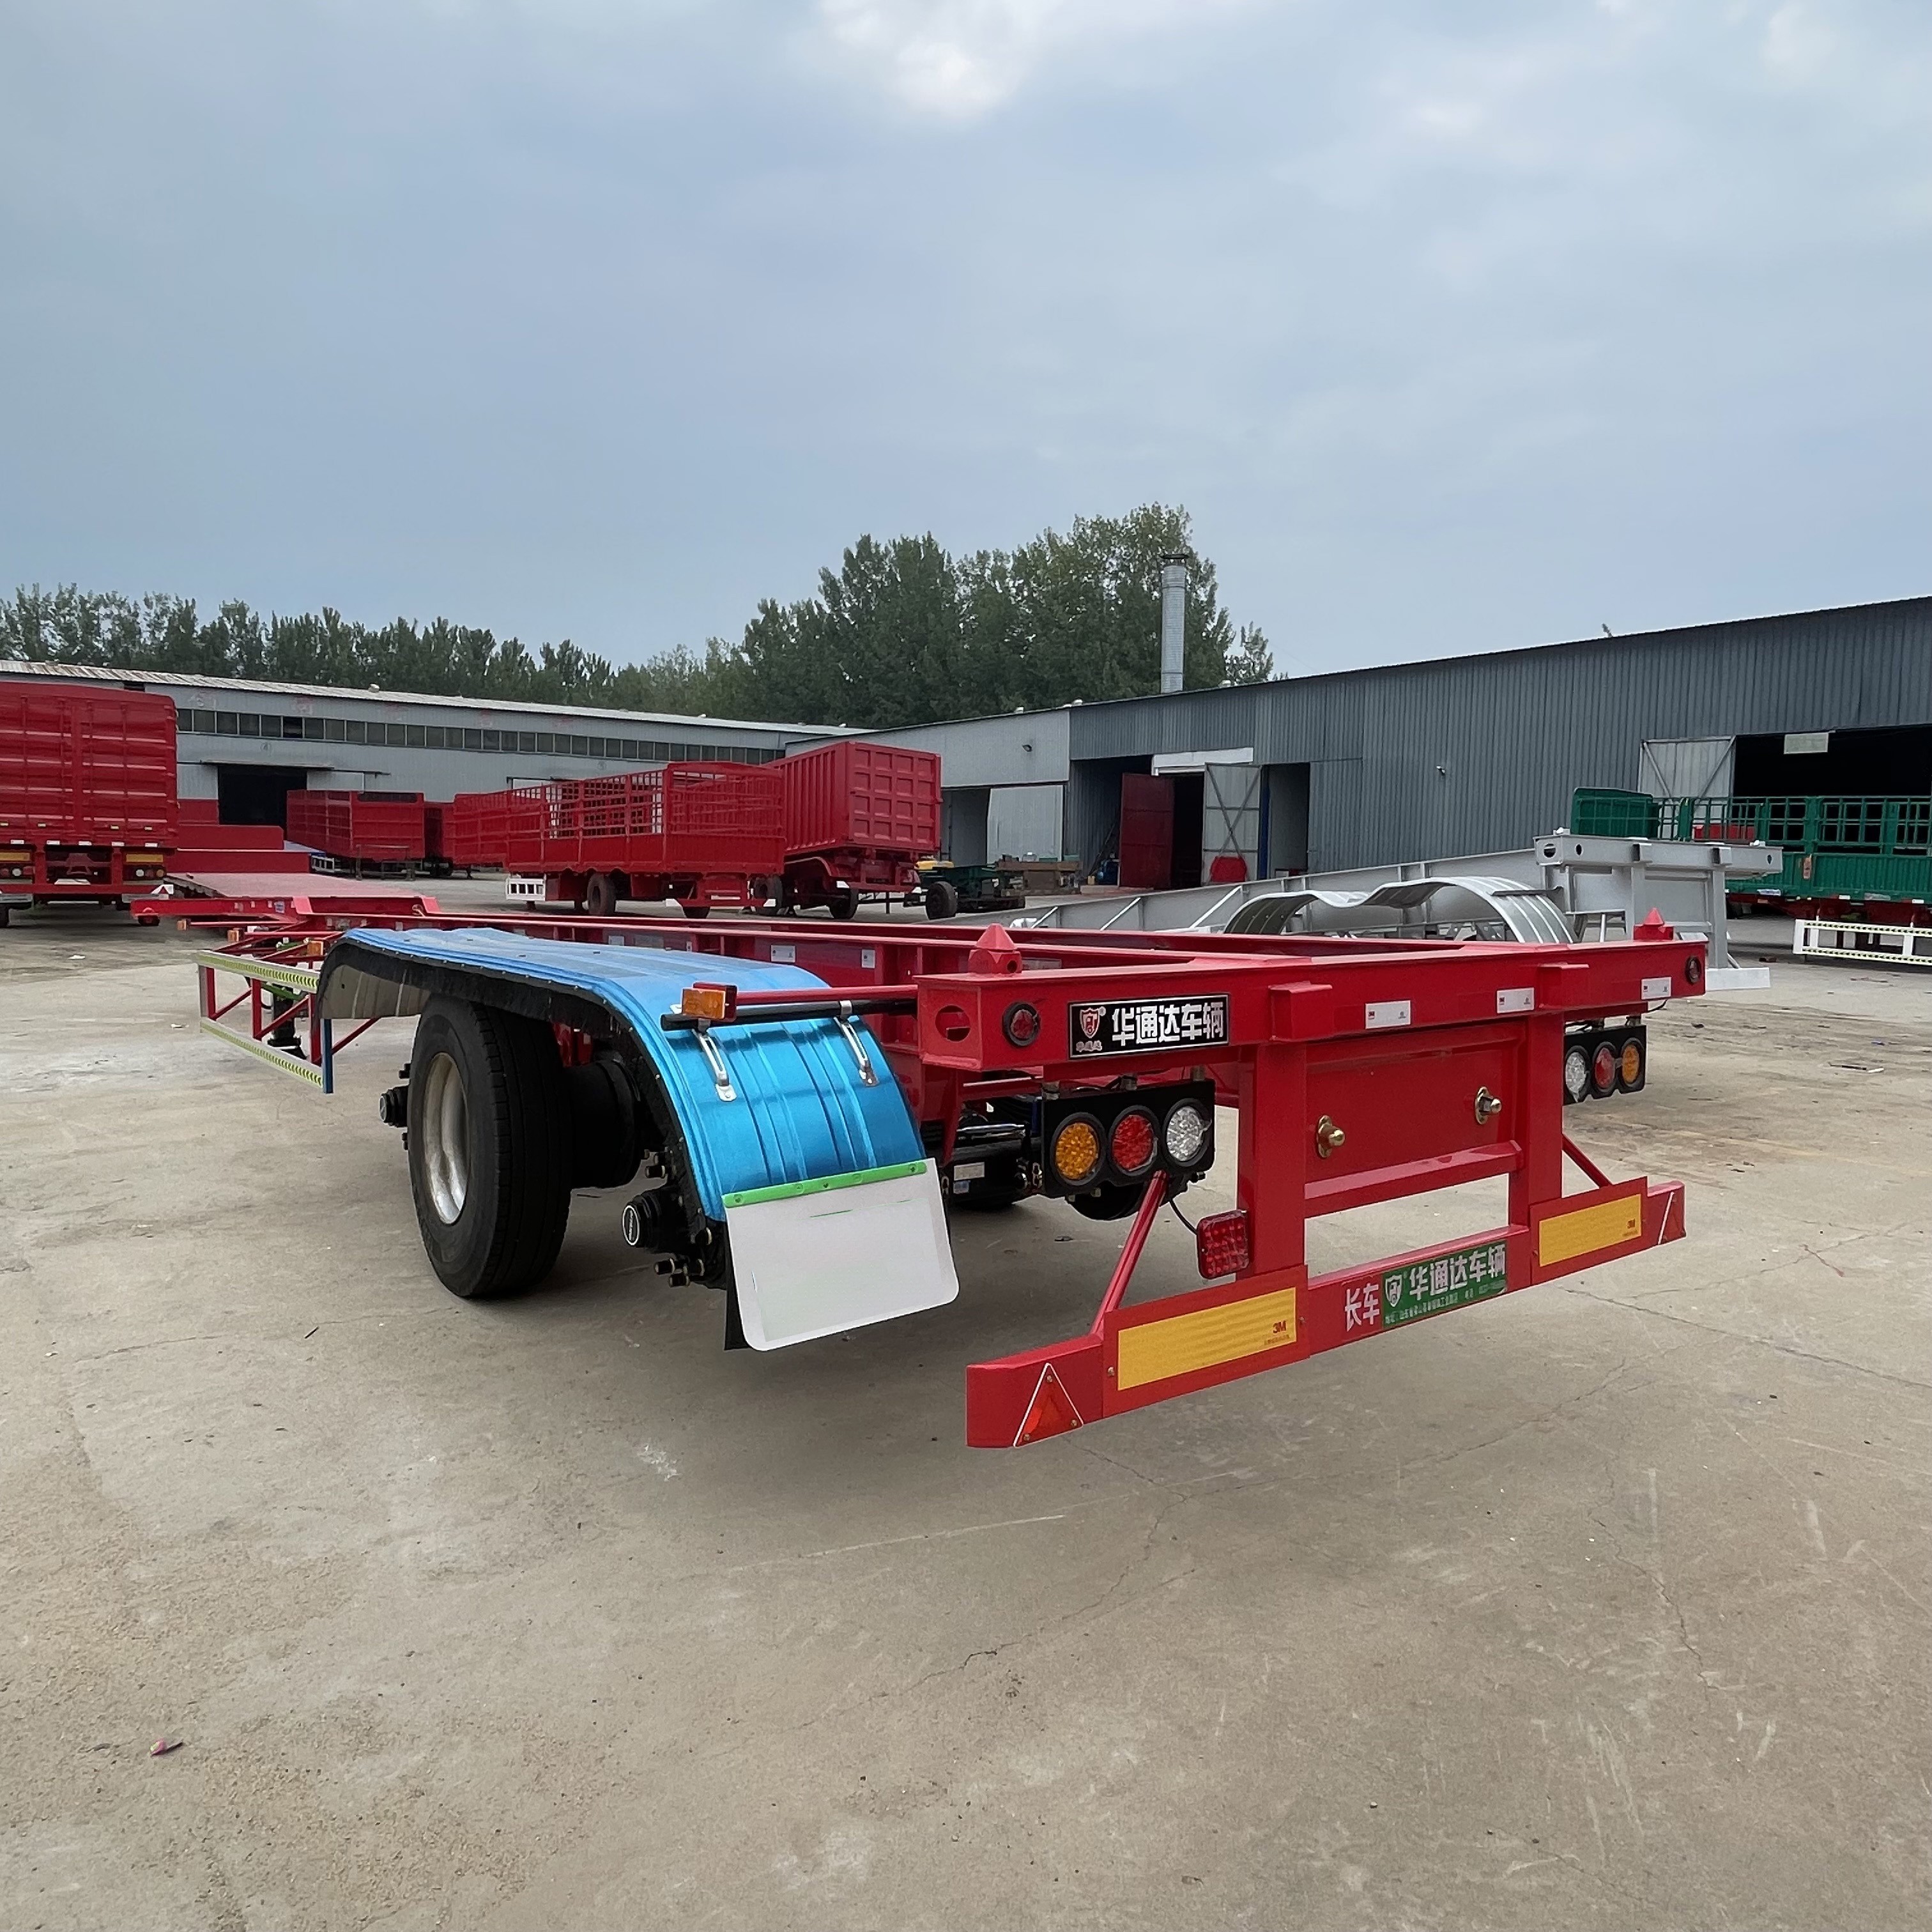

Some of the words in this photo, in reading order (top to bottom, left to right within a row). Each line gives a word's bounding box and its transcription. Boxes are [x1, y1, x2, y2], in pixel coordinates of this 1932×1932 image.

[1112, 1001, 1224, 1046] 华通达车辆
[1409, 1243, 1506, 1301] 华通达车辆
[1273, 1320, 1287, 1334] 3M
[1344, 1282, 1380, 1332] 长车
